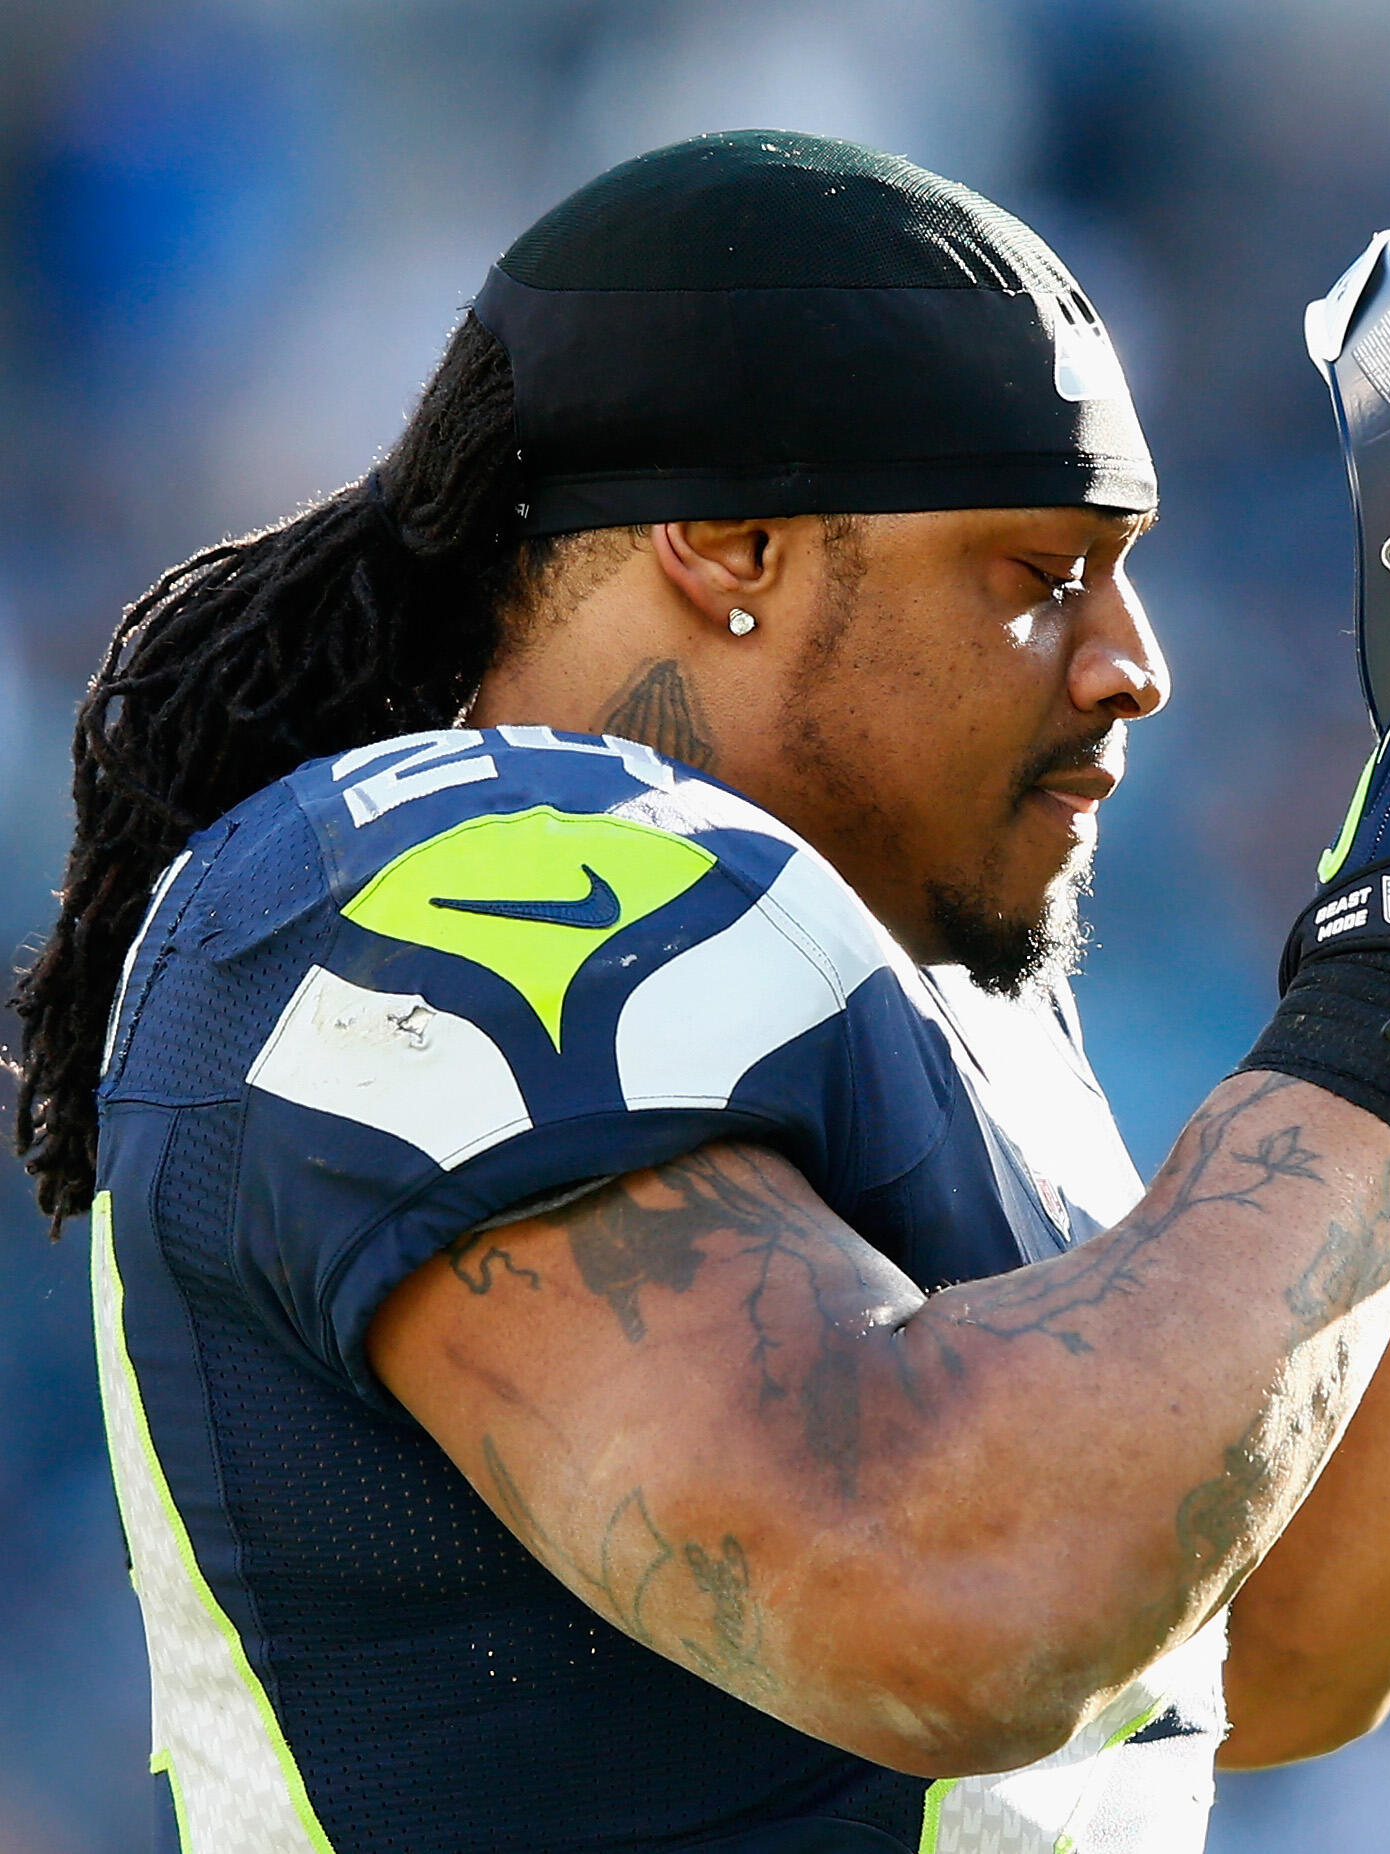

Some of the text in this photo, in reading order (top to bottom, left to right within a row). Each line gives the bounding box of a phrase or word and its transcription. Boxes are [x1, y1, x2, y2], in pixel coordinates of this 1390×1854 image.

[331, 725, 675, 829] 24
[1314, 886, 1373, 925] BEAST
[1317, 909, 1369, 942] MODE
